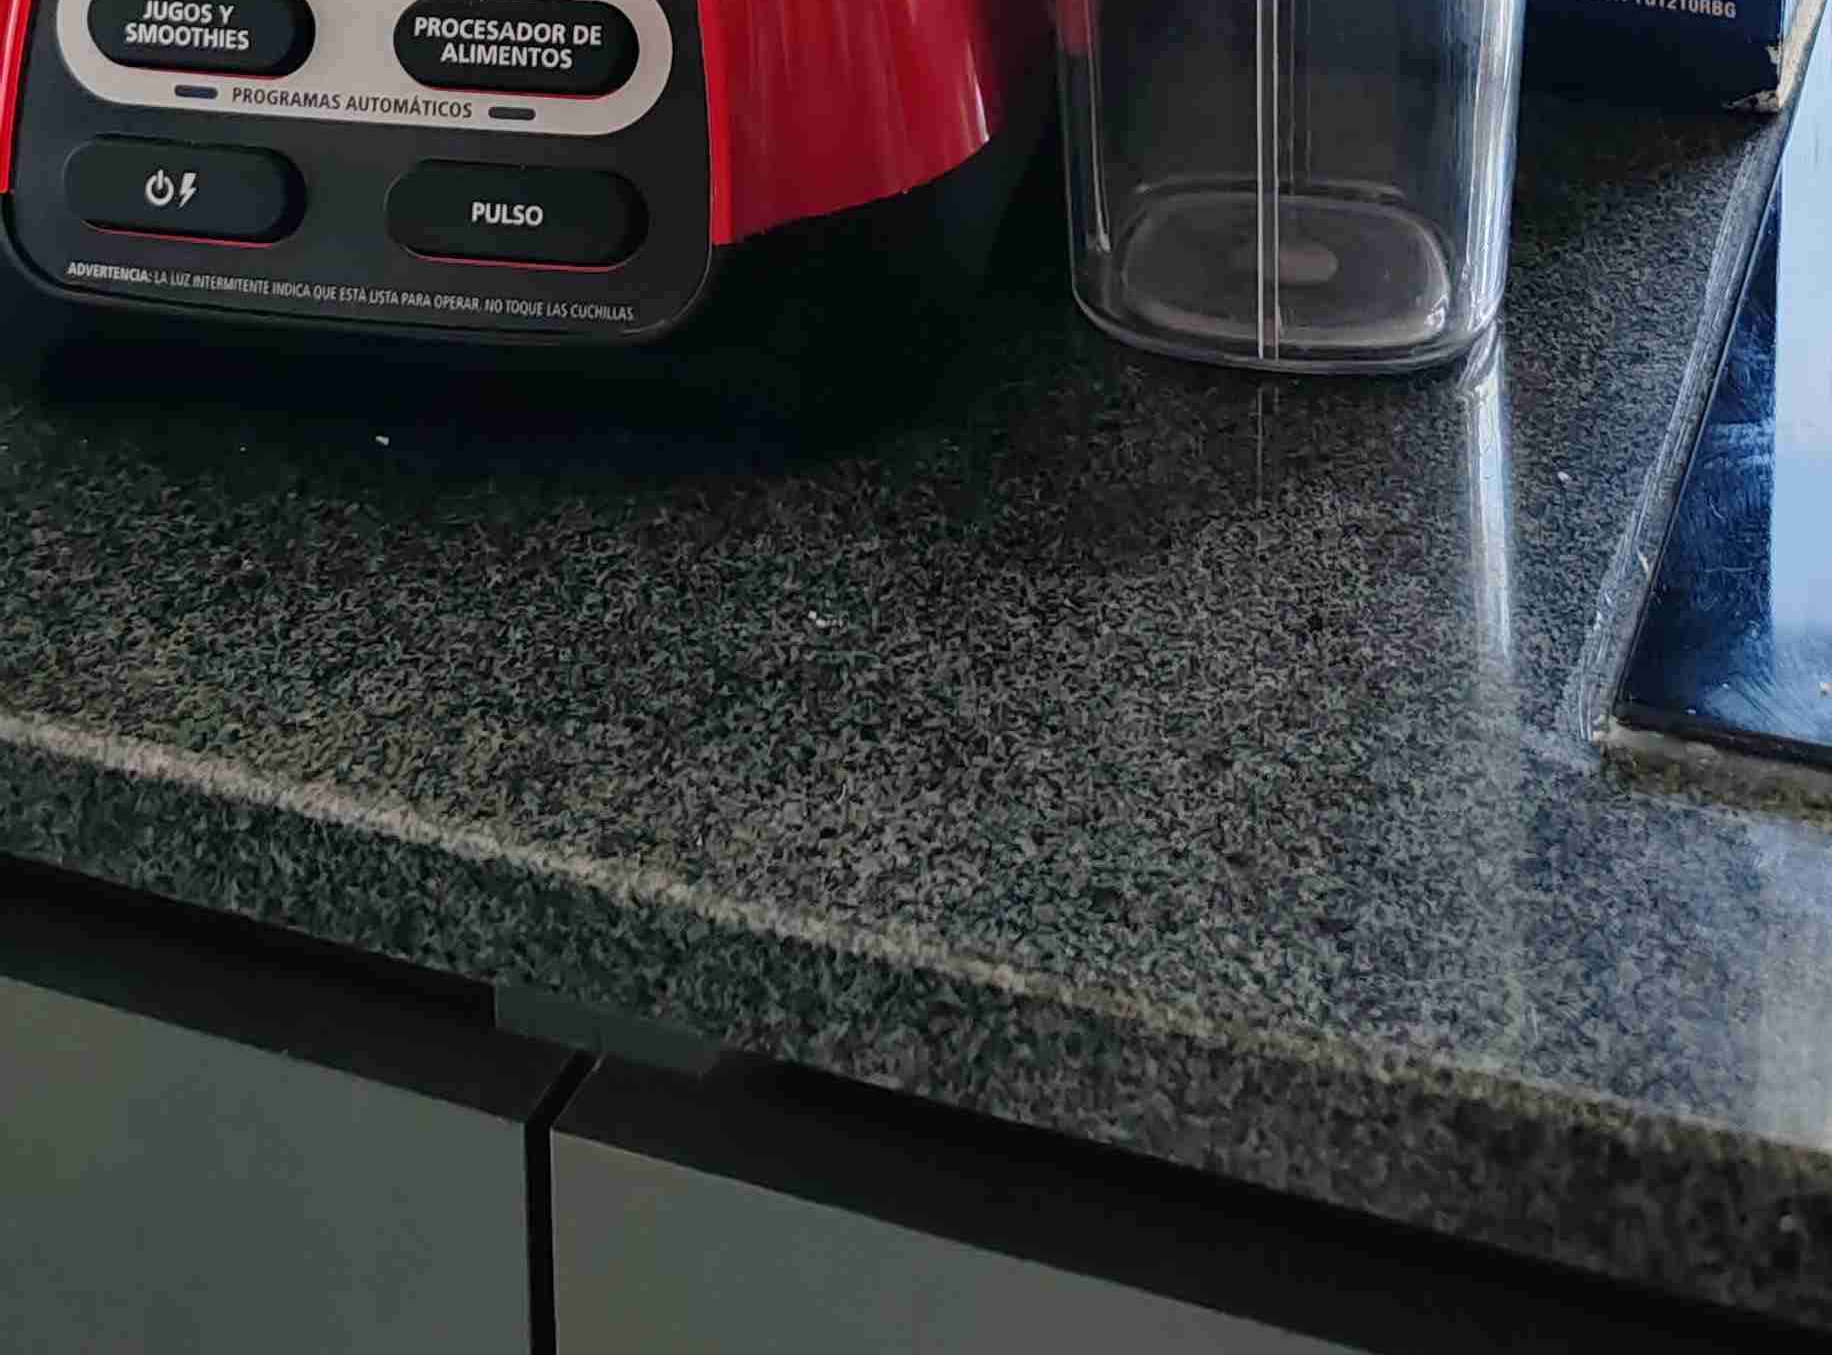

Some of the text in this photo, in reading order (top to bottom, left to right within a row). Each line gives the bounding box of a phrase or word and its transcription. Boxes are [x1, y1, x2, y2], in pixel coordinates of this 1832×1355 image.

[143, 0, 235, 25] JUGOS Y
[125, 23, 250, 51] SMOOTHIES
[413, 16, 602, 46] PROCESADOR DE
[440, 42, 573, 70] ALIMENTOS
[232, 86, 473, 119] PROGRAMAS AUTOMÁTICOS
[471, 201, 544, 227] PULSO
[67, 261, 151, 284] ADVERTENCIA:
[153, 272, 168, 285] LA
[170, 273, 191, 288] LUZ
[193, 275, 269, 296] INTERMITENTE
[271, 281, 312, 298] INDICA
[313, 284, 337, 301] QUE
[368, 288, 400, 305] LISTA
[401, 291, 433, 308] PARA
[484, 297, 503, 313] NO
[505, 298, 543, 316] TOQUE
[546, 302, 568, 319] LAS
